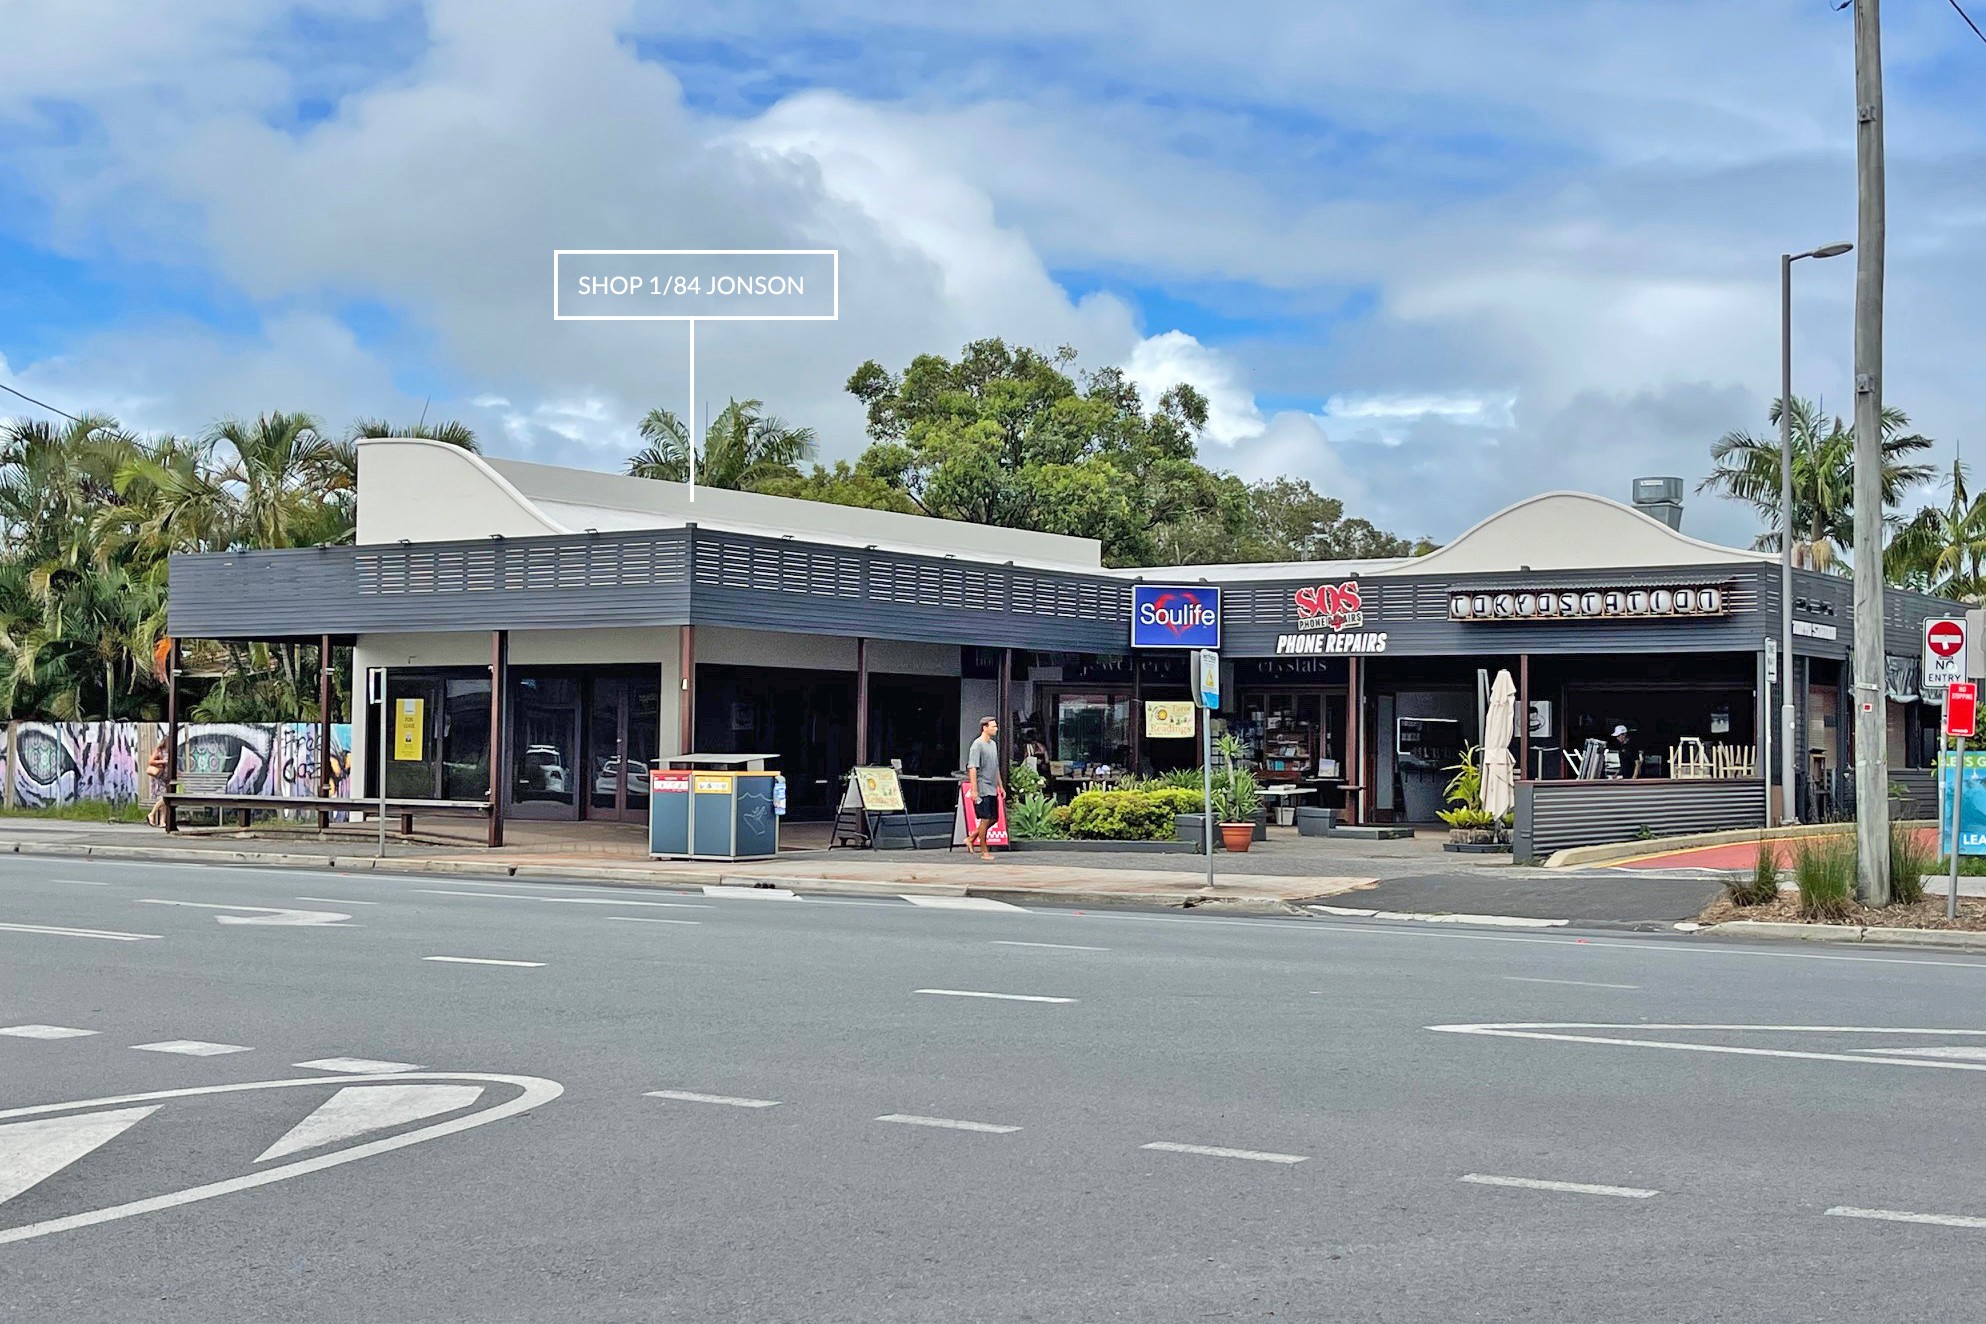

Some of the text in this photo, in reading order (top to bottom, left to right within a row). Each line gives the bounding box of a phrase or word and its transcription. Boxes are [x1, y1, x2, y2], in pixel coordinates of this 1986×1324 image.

[1295, 581, 1362, 618] SOS
[1140, 603, 1216, 626] Soulife
[1299, 612, 1362, 630] PHONE RAIRS
[1276, 632, 1387, 654] PHONE REPAIRS
[1928, 673, 1962, 682] ENTRY
[1150, 723, 1192, 736] Readings
[282, 757, 322, 784] Gaz
